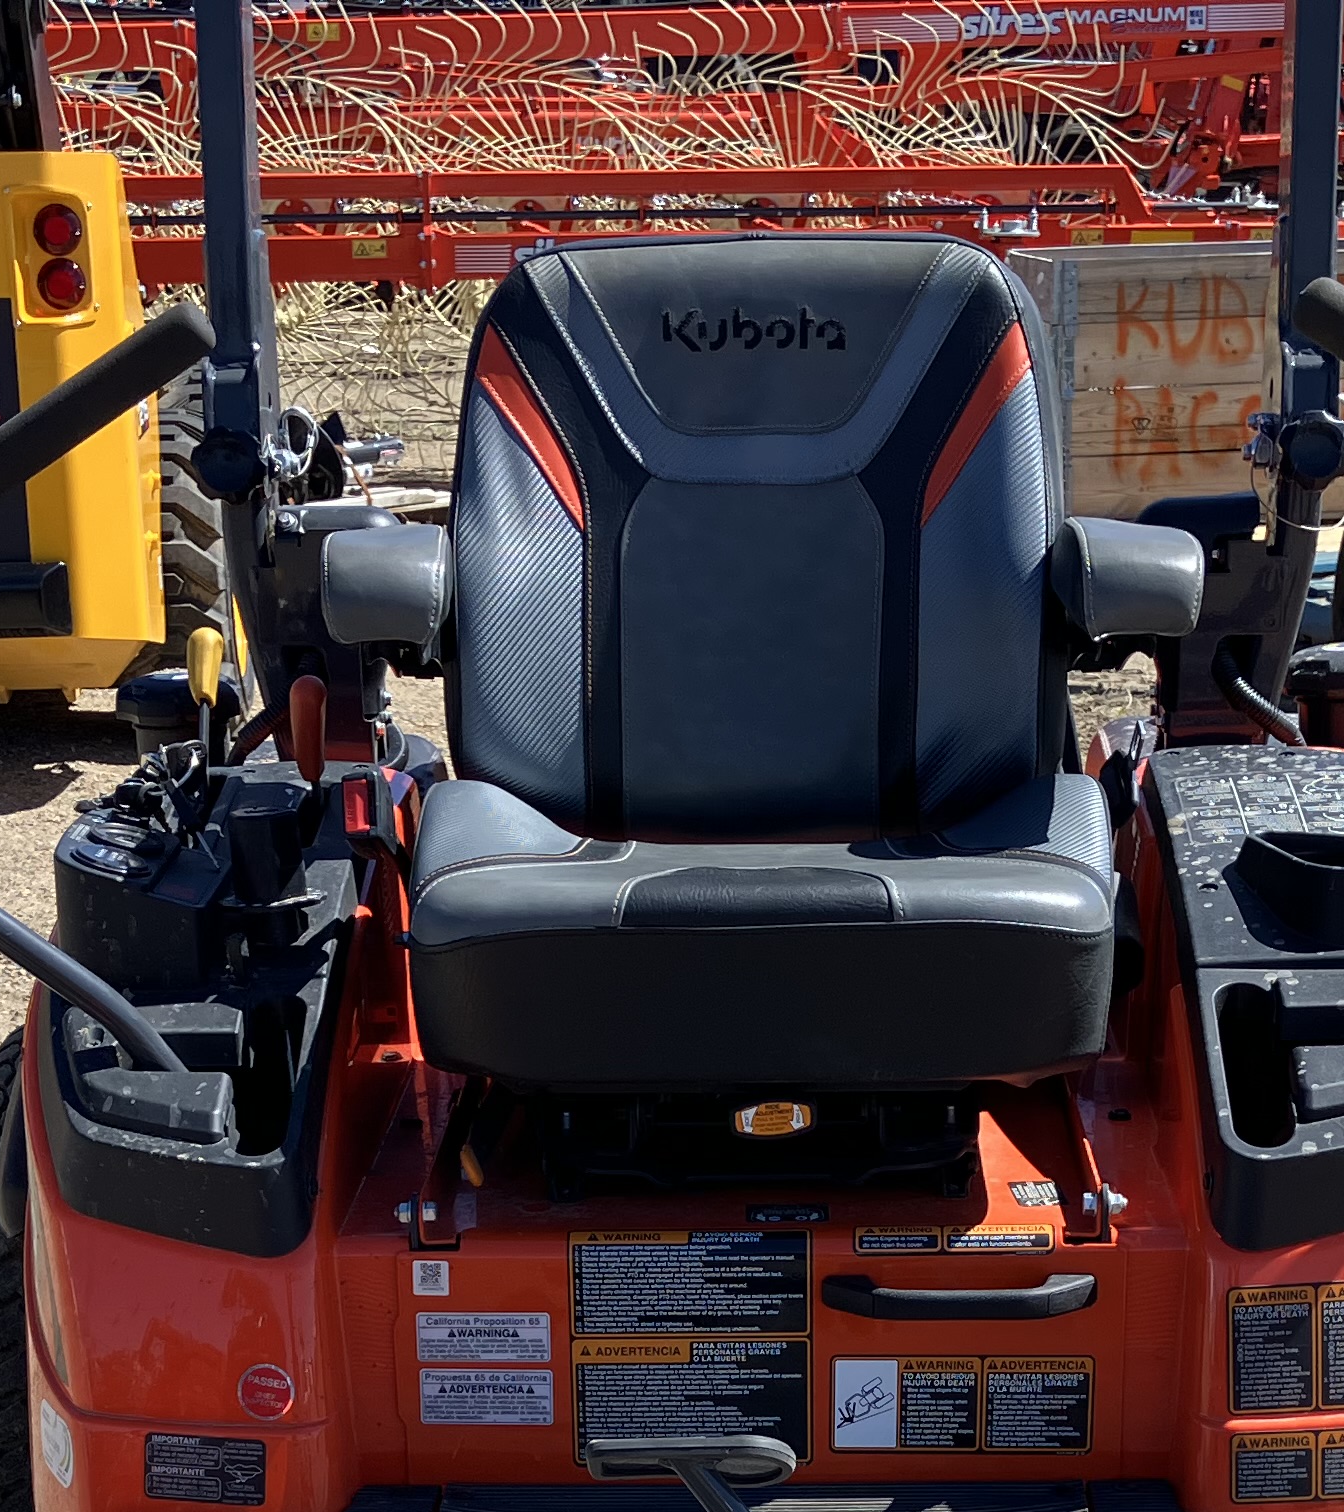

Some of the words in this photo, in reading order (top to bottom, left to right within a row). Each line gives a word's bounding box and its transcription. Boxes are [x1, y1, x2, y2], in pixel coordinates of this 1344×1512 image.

[1070, 7, 1186, 25] MAGNUM
[661, 304, 847, 352] Kubota
[603, 1233, 660, 1241] WARNING
[1248, 1289, 1308, 1303] WARNING
[1248, 1305, 1272, 1313] AVOID
[1280, 1310, 1308, 1319] DEATH
[425, 1317, 471, 1327] California
[474, 1317, 525, 1327] Proposition
[528, 1317, 541, 1327] 65
[456, 1329, 511, 1338] WARNING
[596, 1347, 681, 1356] ADVERTENCIA
[916, 1361, 974, 1370] WARNING
[1000, 1361, 1086, 1370] ADVERTENCIA
[247, 1374, 288, 1390] PASSED
[424, 1374, 471, 1382] Propuesta
[474, 1374, 485, 1382] 65
[489, 1374, 500, 1382] de
[503, 1374, 548, 1382] California
[449, 1385, 524, 1394] ADVERTENCIA
[151, 1434, 200, 1445] IMPORTANT
[1248, 1436, 1310, 1448] WARNING
[151, 1466, 205, 1477] IMPORTANTE
